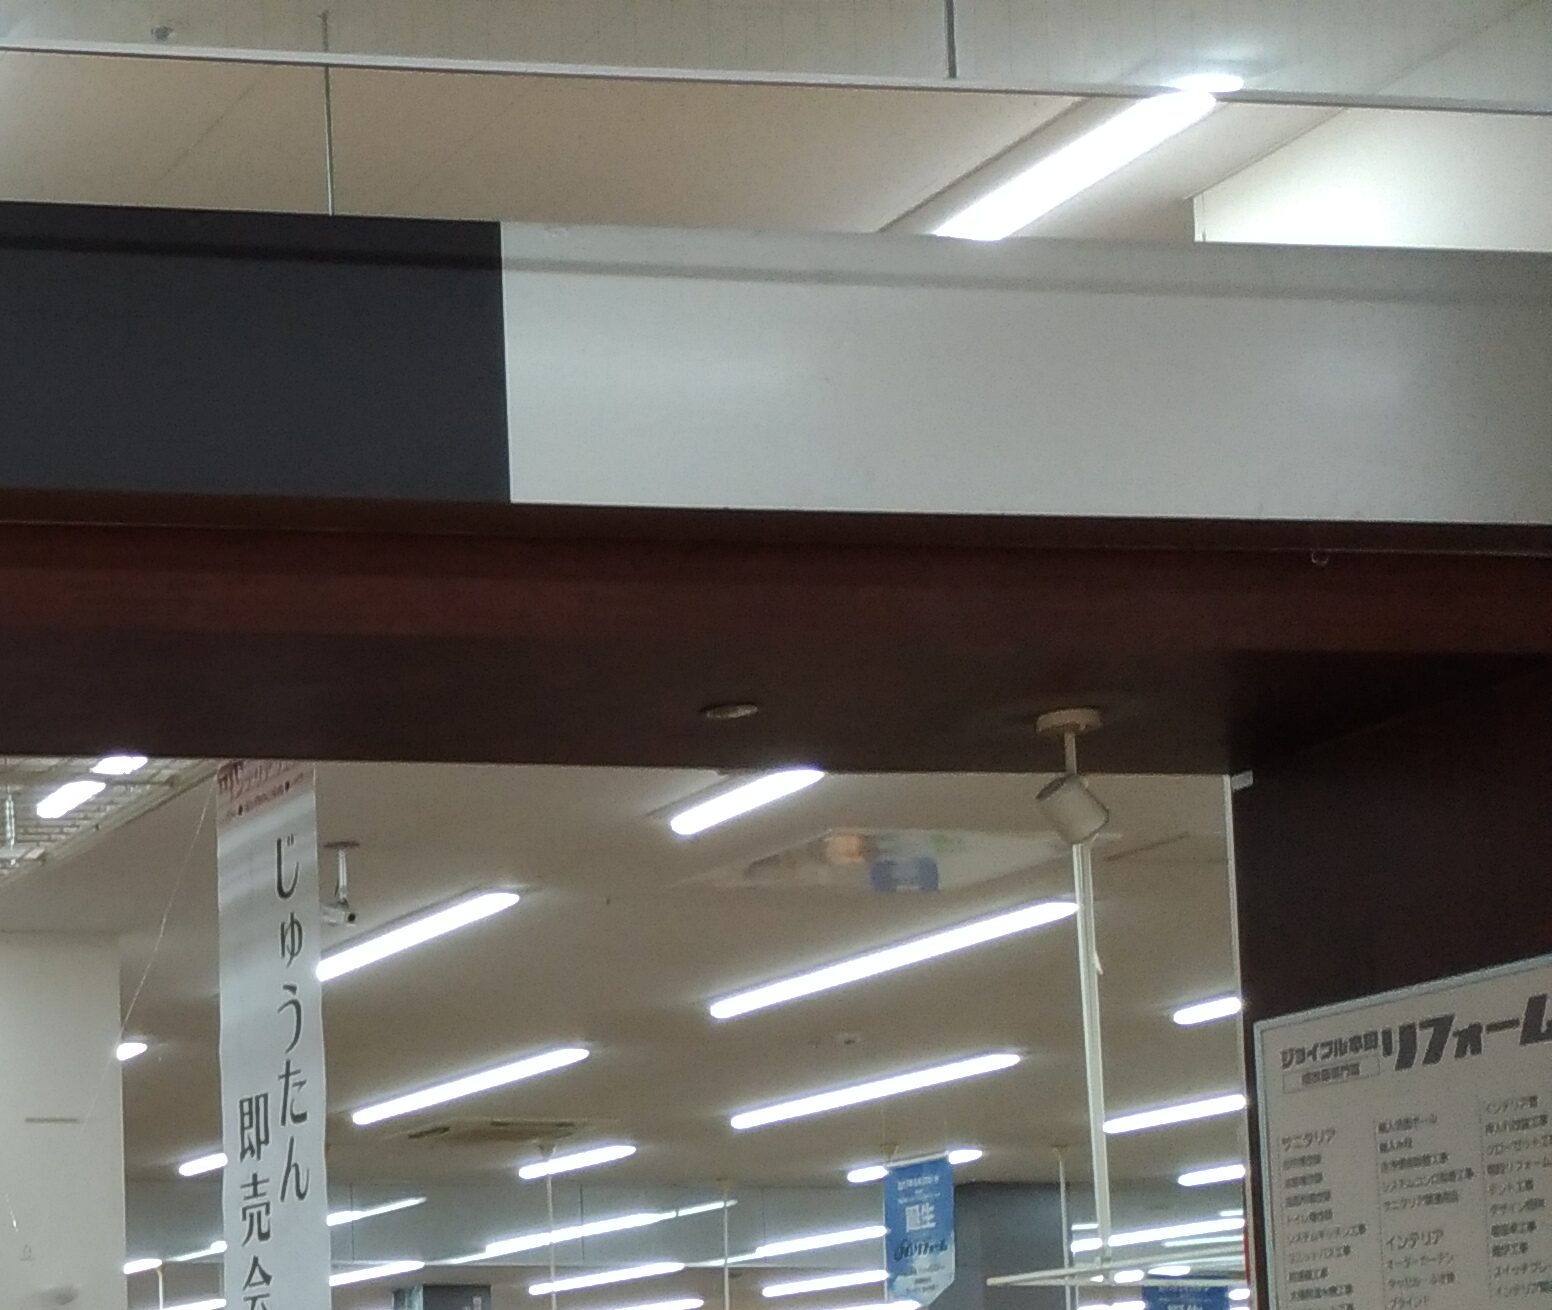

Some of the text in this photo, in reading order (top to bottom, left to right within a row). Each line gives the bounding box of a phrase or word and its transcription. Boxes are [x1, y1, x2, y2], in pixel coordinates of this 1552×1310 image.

[274, 836, 310, 1202] じゅうたん
[1280, 993, 1552, 1071] ジョイフル本田 リフォーム
[1385, 1229, 1444, 1251] インテリア
